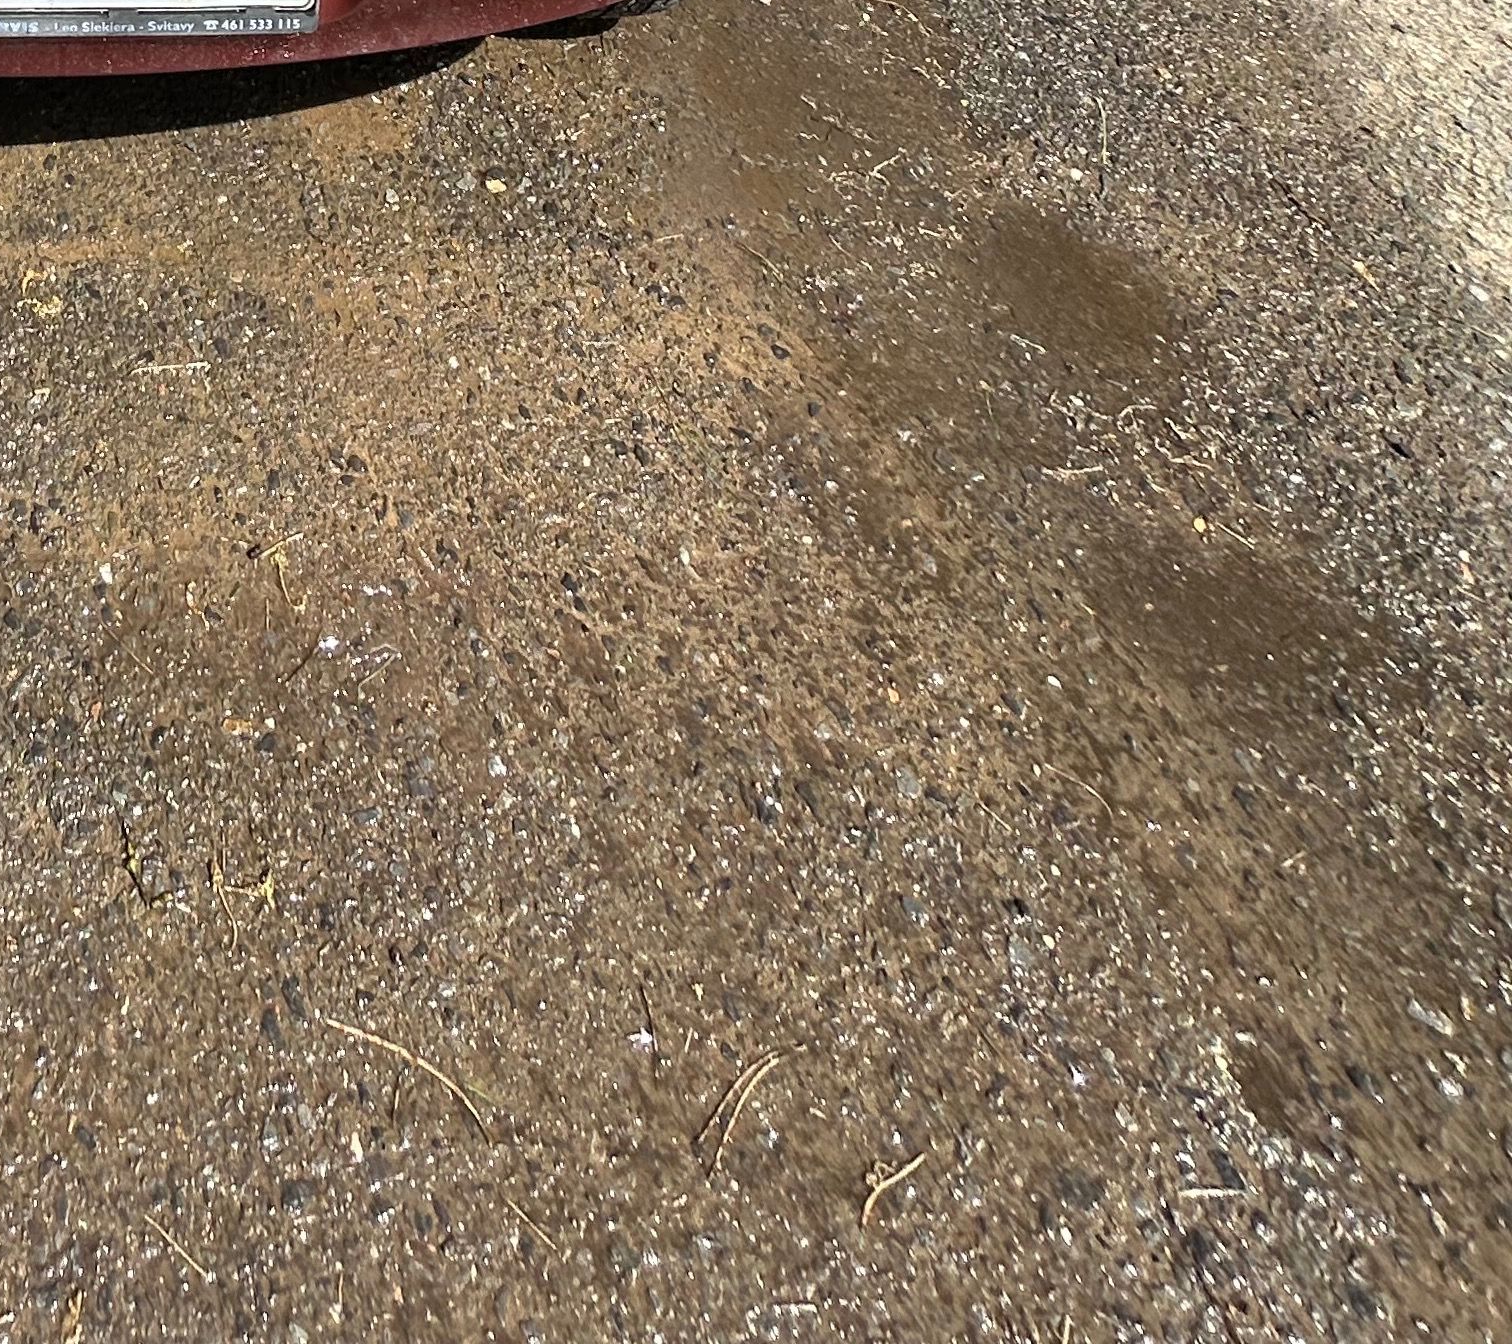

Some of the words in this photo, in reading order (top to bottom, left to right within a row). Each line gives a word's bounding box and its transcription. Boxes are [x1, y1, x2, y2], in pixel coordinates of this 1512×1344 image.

[220, 20, 244, 31] 461
[248, 19, 273, 30] 533
[278, 18, 301, 30] 115
